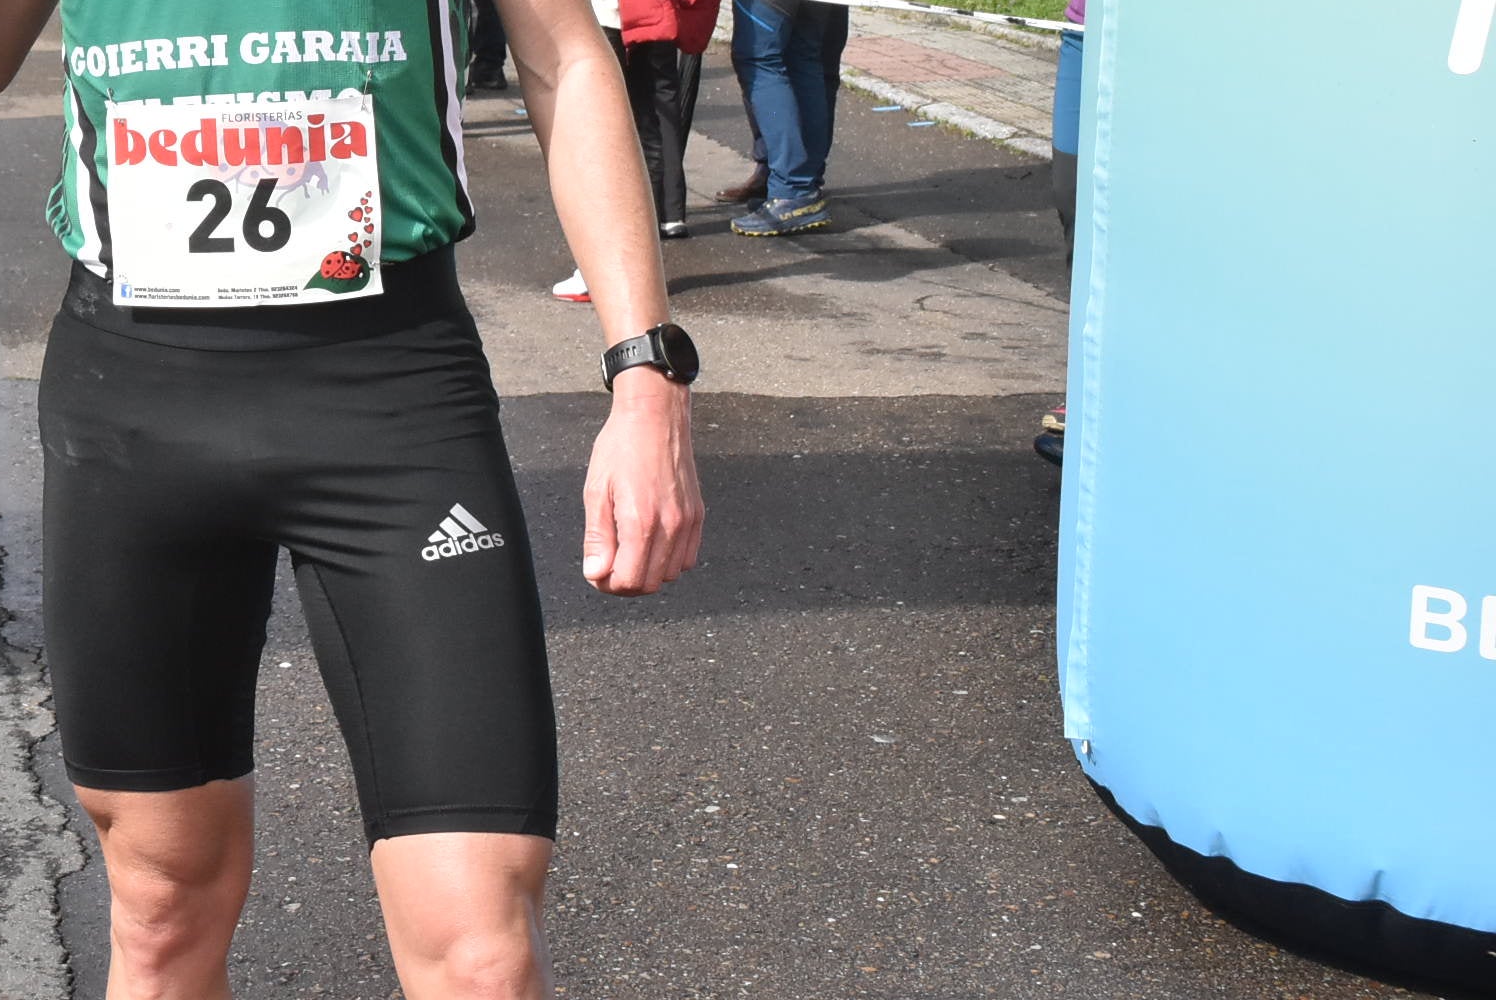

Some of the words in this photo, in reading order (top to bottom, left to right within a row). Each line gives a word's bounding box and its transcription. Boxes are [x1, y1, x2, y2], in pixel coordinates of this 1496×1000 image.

[70, 34, 229, 77] GOIERRI
[239, 30, 408, 65] GARAIA
[112, 113, 368, 167] bedunia
[221, 110, 303, 123] FLORISTERÍAS
[186, 177, 292, 253] 26
[421, 533, 505, 561] adidas
